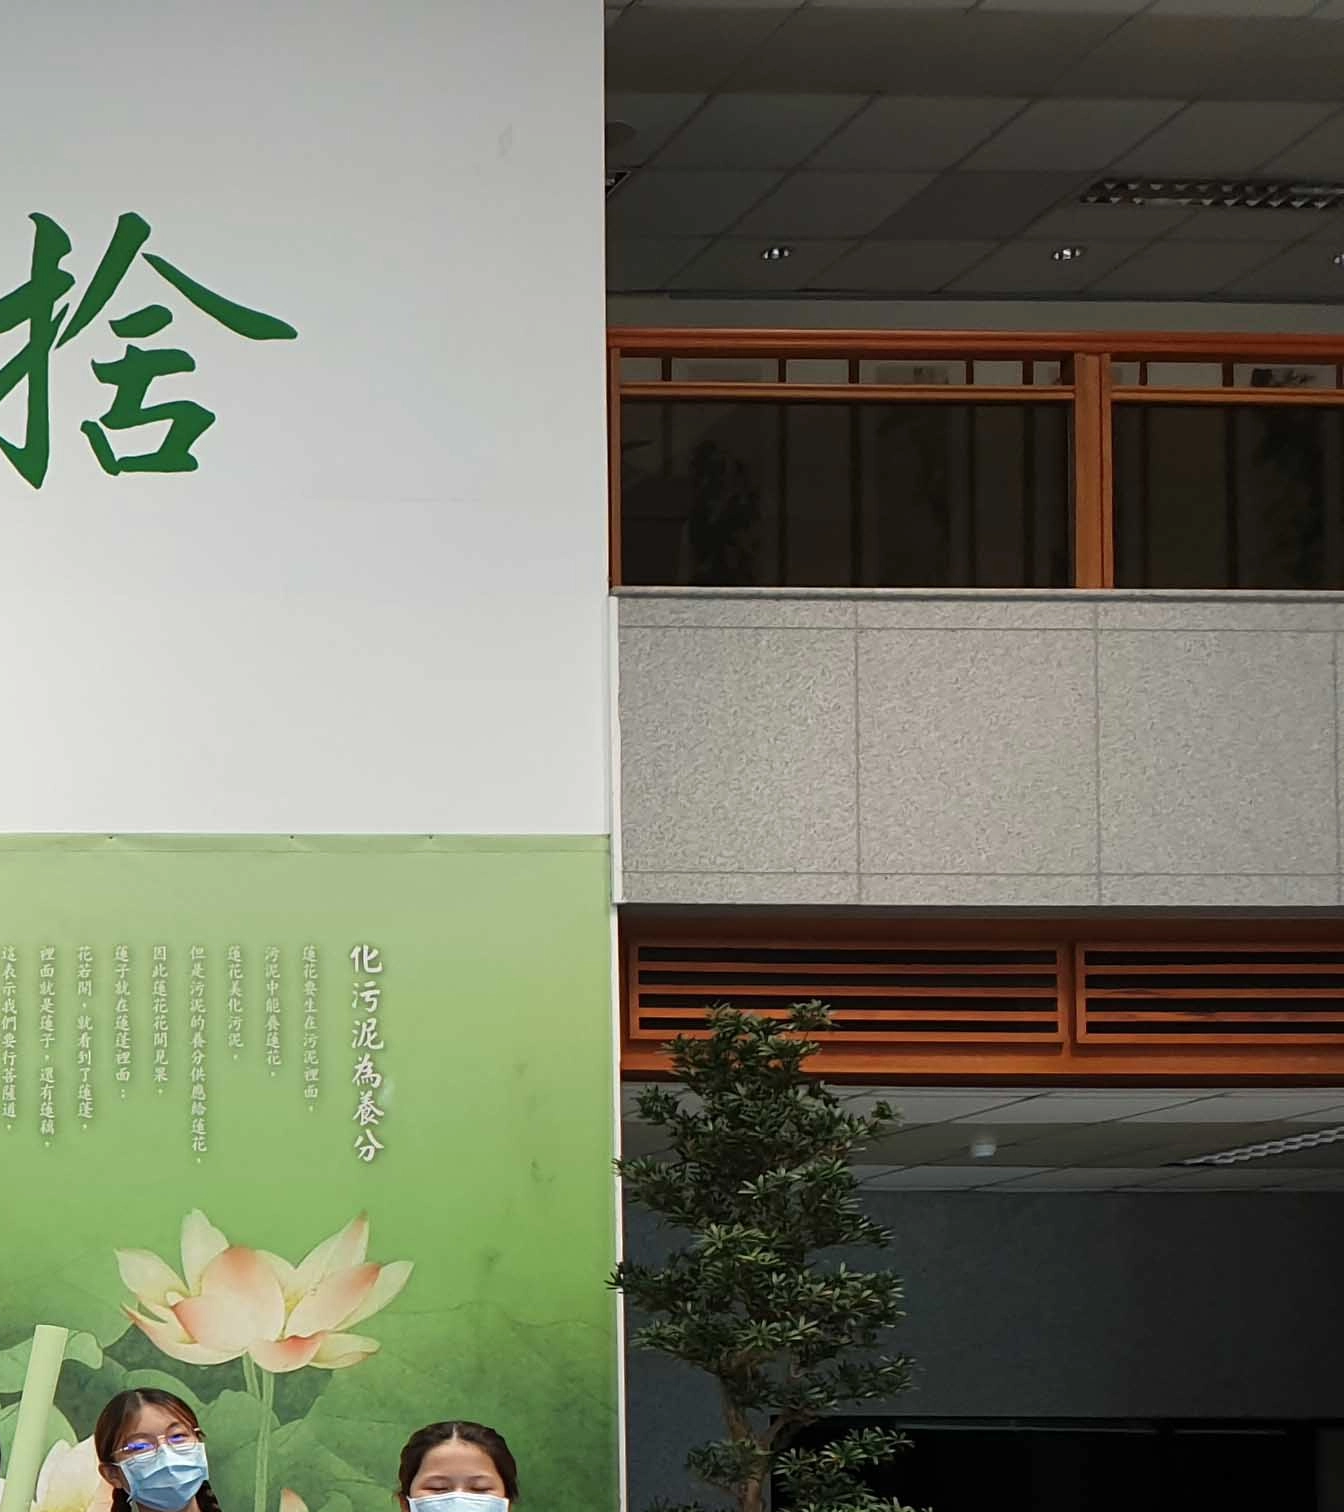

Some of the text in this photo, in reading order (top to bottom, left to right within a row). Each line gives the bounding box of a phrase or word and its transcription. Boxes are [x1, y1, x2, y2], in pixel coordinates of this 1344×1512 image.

[350, 943, 385, 1162] 化污泥為養分
